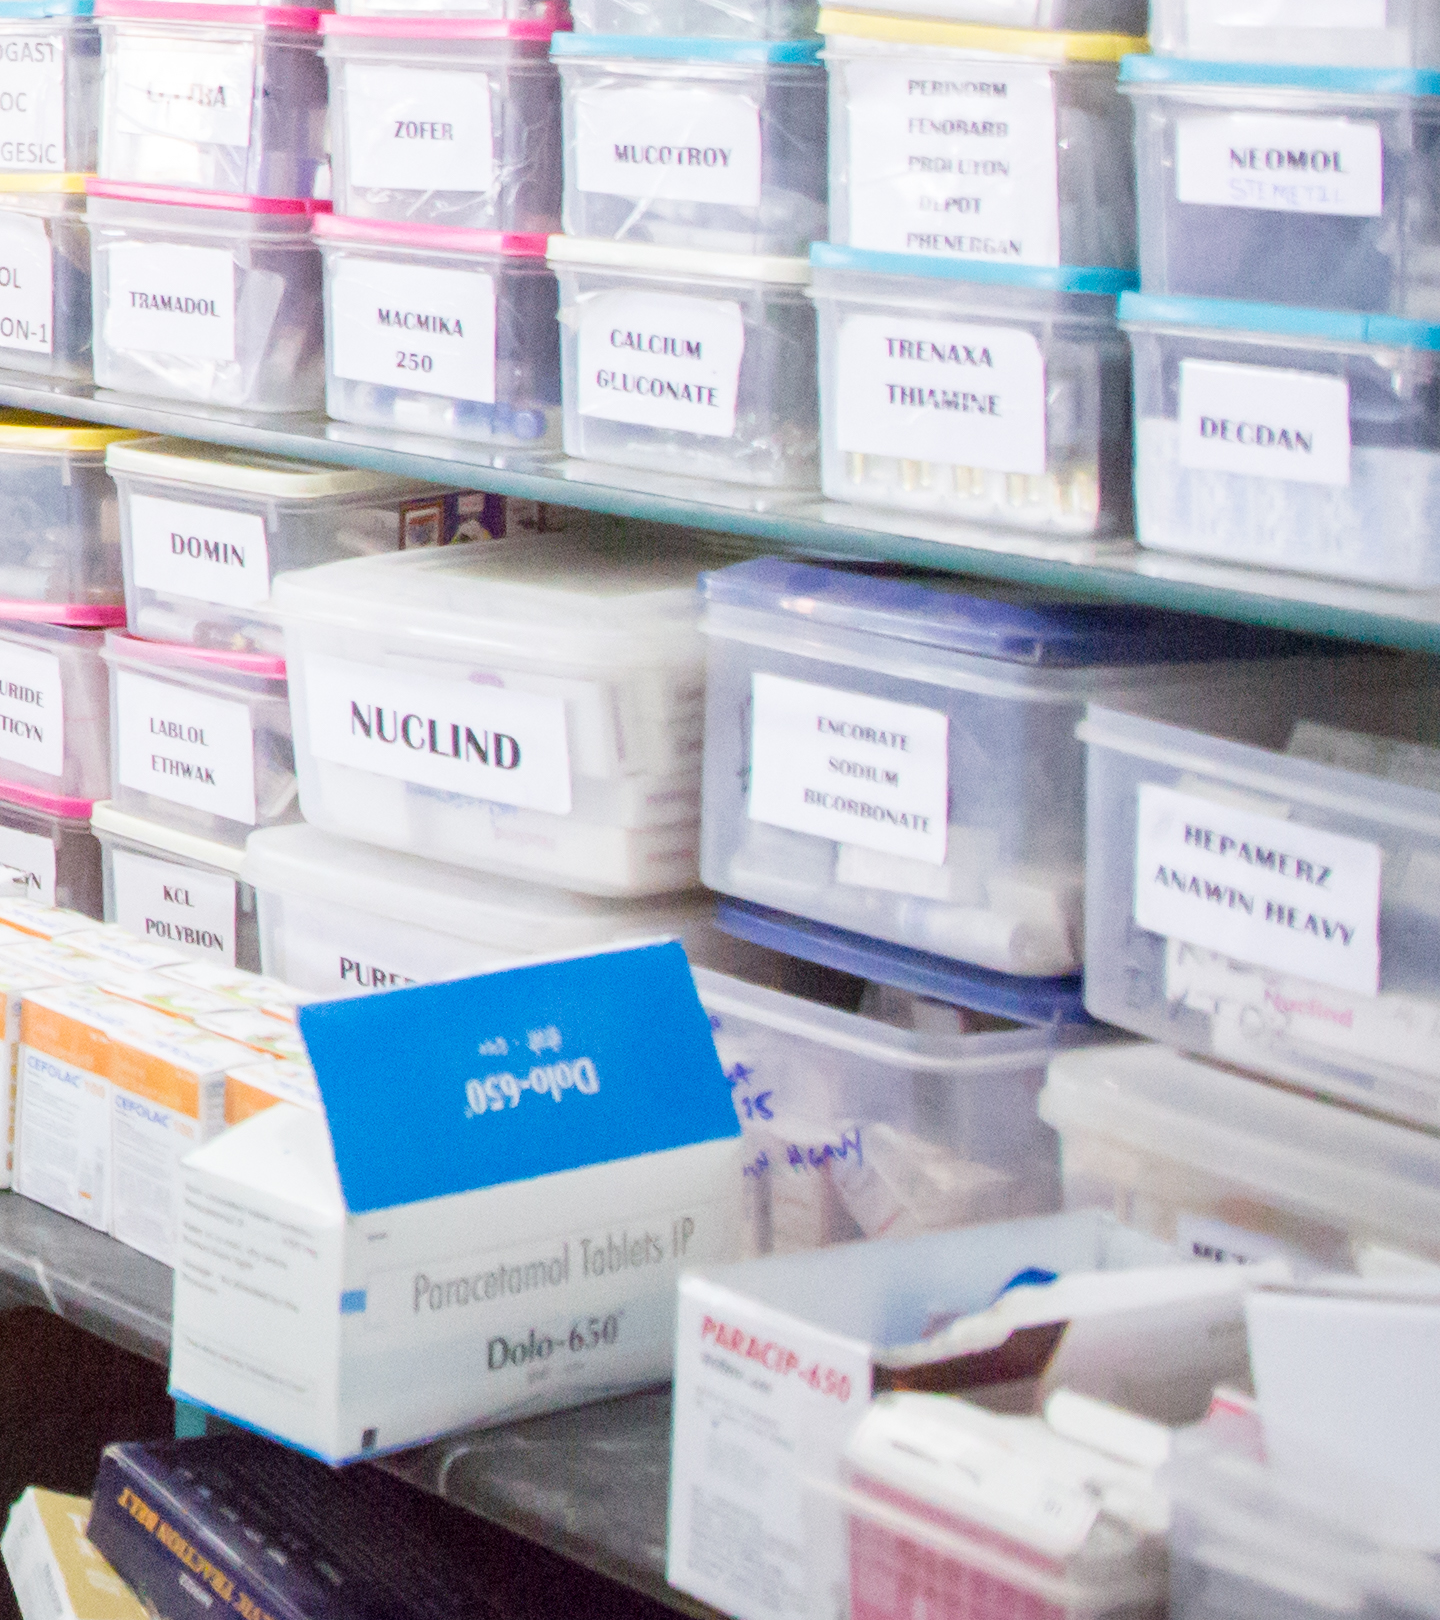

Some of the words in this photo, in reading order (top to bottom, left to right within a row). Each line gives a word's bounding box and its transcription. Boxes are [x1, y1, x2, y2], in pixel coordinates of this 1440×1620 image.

[907, 78, 1008, 100] PERINORM
[393, 119, 454, 142] ZOFER
[907, 117, 1009, 139] FENOBARB
[614, 143, 733, 168] MUCOTROY
[1229, 147, 1349, 174] NEOMOL
[906, 230, 1022, 256] PHENERGAN
[129, 291, 220, 318] TRAMADOL
[377, 308, 464, 339] MACMIKA
[396, 351, 434, 373] 250
[609, 328, 703, 361] CALCIUM
[885, 336, 994, 369] TRENAXA
[596, 369, 719, 408] GLUCONATE
[885, 383, 1003, 418] THIAMINE
[170, 532, 246, 568] DOMIN
[149, 716, 209, 748] LABLOL
[348, 698, 523, 774] NUCLIND
[817, 715, 910, 753] ENCORATE
[150, 752, 216, 787] ETHWAK
[827, 755, 899, 789] SODIUM
[803, 787, 932, 835] BICORBONATE
[1183, 822, 1334, 890] HEPAMERZ
[162, 884, 195, 909] KCL
[1153, 863, 1255, 918] ANAWIN
[1263, 897, 1357, 948] HEAVY
[144, 916, 225, 953] POLYBION
[27, 1053, 81, 1089] CEFOLAC
[463, 1057, 599, 1118] Dolo-650
[114, 1093, 172, 1130] CEFOLAC
[412, 1241, 571, 1314] Paracetamol
[580, 1228, 664, 1276] Tablets
[672, 1214, 695, 1255] IP
[486, 1312, 619, 1375] Dolo-650
[700, 1312, 852, 1404] PARACIP-650
